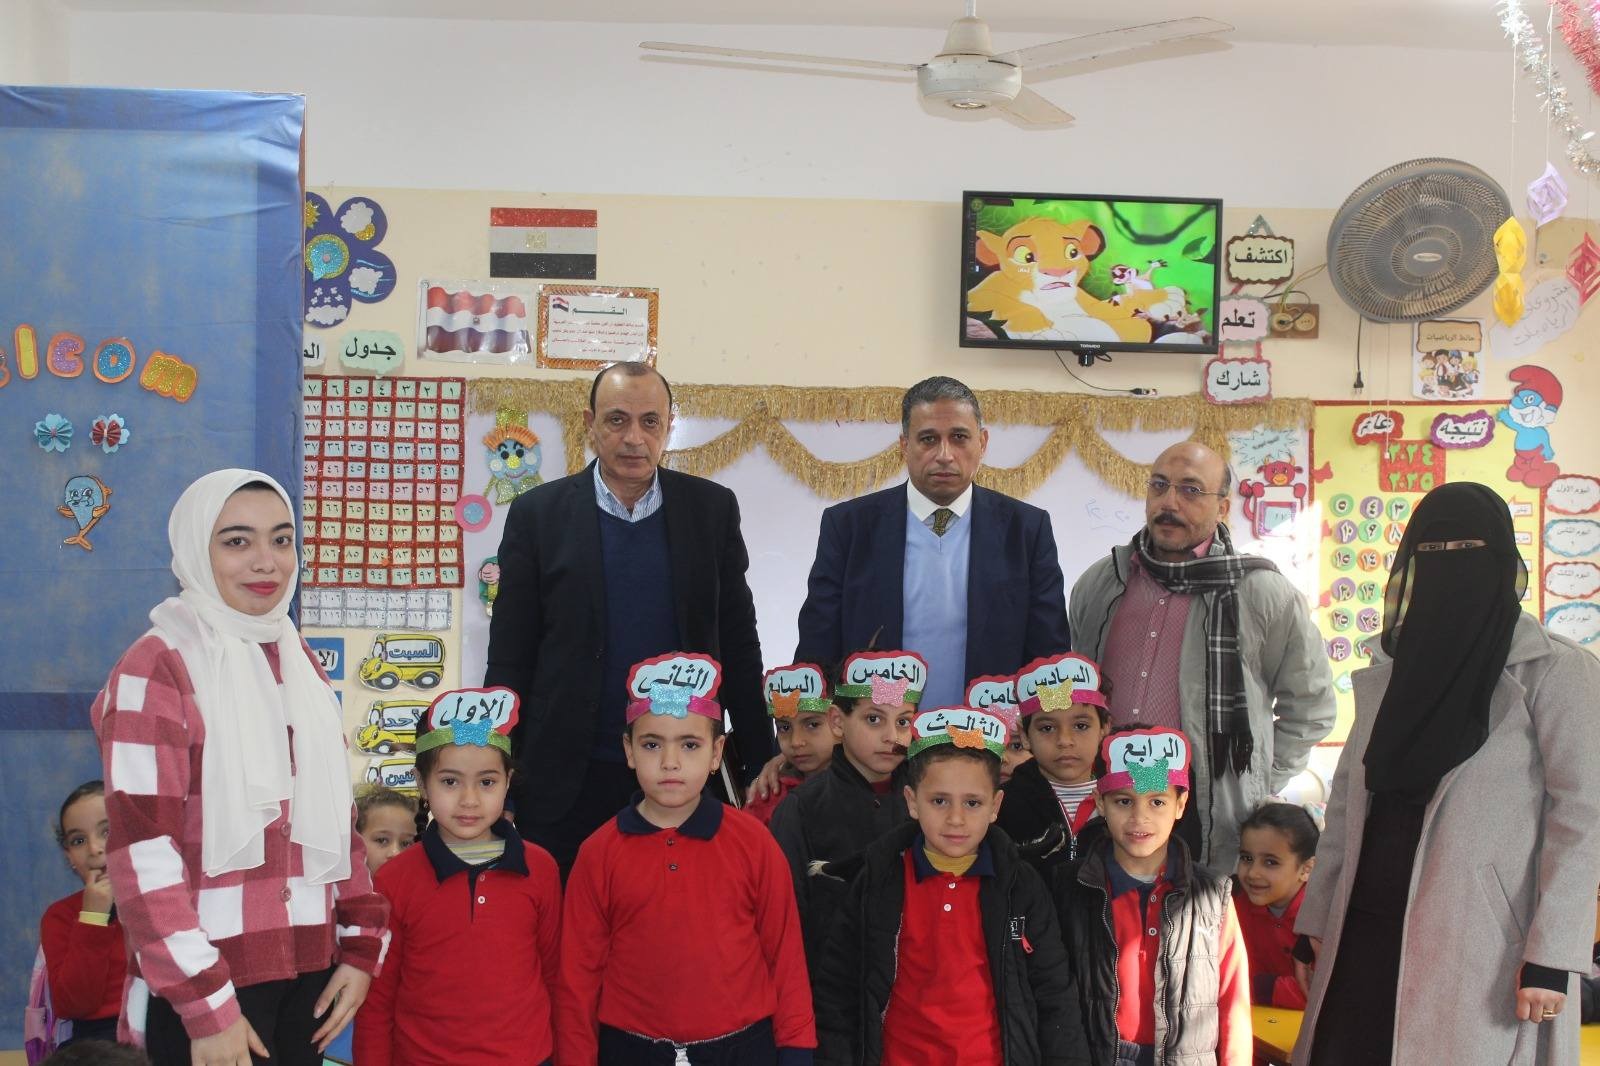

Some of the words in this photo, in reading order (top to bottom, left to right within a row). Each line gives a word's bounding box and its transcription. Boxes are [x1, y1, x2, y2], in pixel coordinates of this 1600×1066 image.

[1234, 247, 1288, 264] اكتشف
[1222, 307, 1254, 336] تعلم
[346, 336, 396, 360] جدول
[1216, 370, 1260, 390] شارك
[309, 385, 316, 394] ٧
[332, 385, 339, 395] ٦
[380, 385, 384, 395] ٤
[424, 387, 430, 396] ٢
[330, 405, 341, 413] ١٦
[377, 404, 388, 412] ١٤
[374, 444, 385, 453] ٣٤
[374, 465, 384, 473] ٤٤
[444, 467, 455, 475] ٤١
[326, 504, 338, 512] ٦٦
[1338, 500, 1347, 510] ٥
[371, 528, 383, 536] ٧٤
[1369, 524, 1376, 536] ٩
[1338, 552, 1350, 564] ١٥
[1364, 554, 1376, 566] ١٤
[324, 569, 337, 578] ٩٦
[371, 571, 382, 579] ٩٤
[442, 570, 454, 578] ٩١
[388, 642, 438, 660] السبت
[852, 662, 920, 684] الخامس
[1026, 665, 1090, 696] السادس
[926, 713, 999, 738] الثالث
[1123, 737, 1178, 765] الرابع
